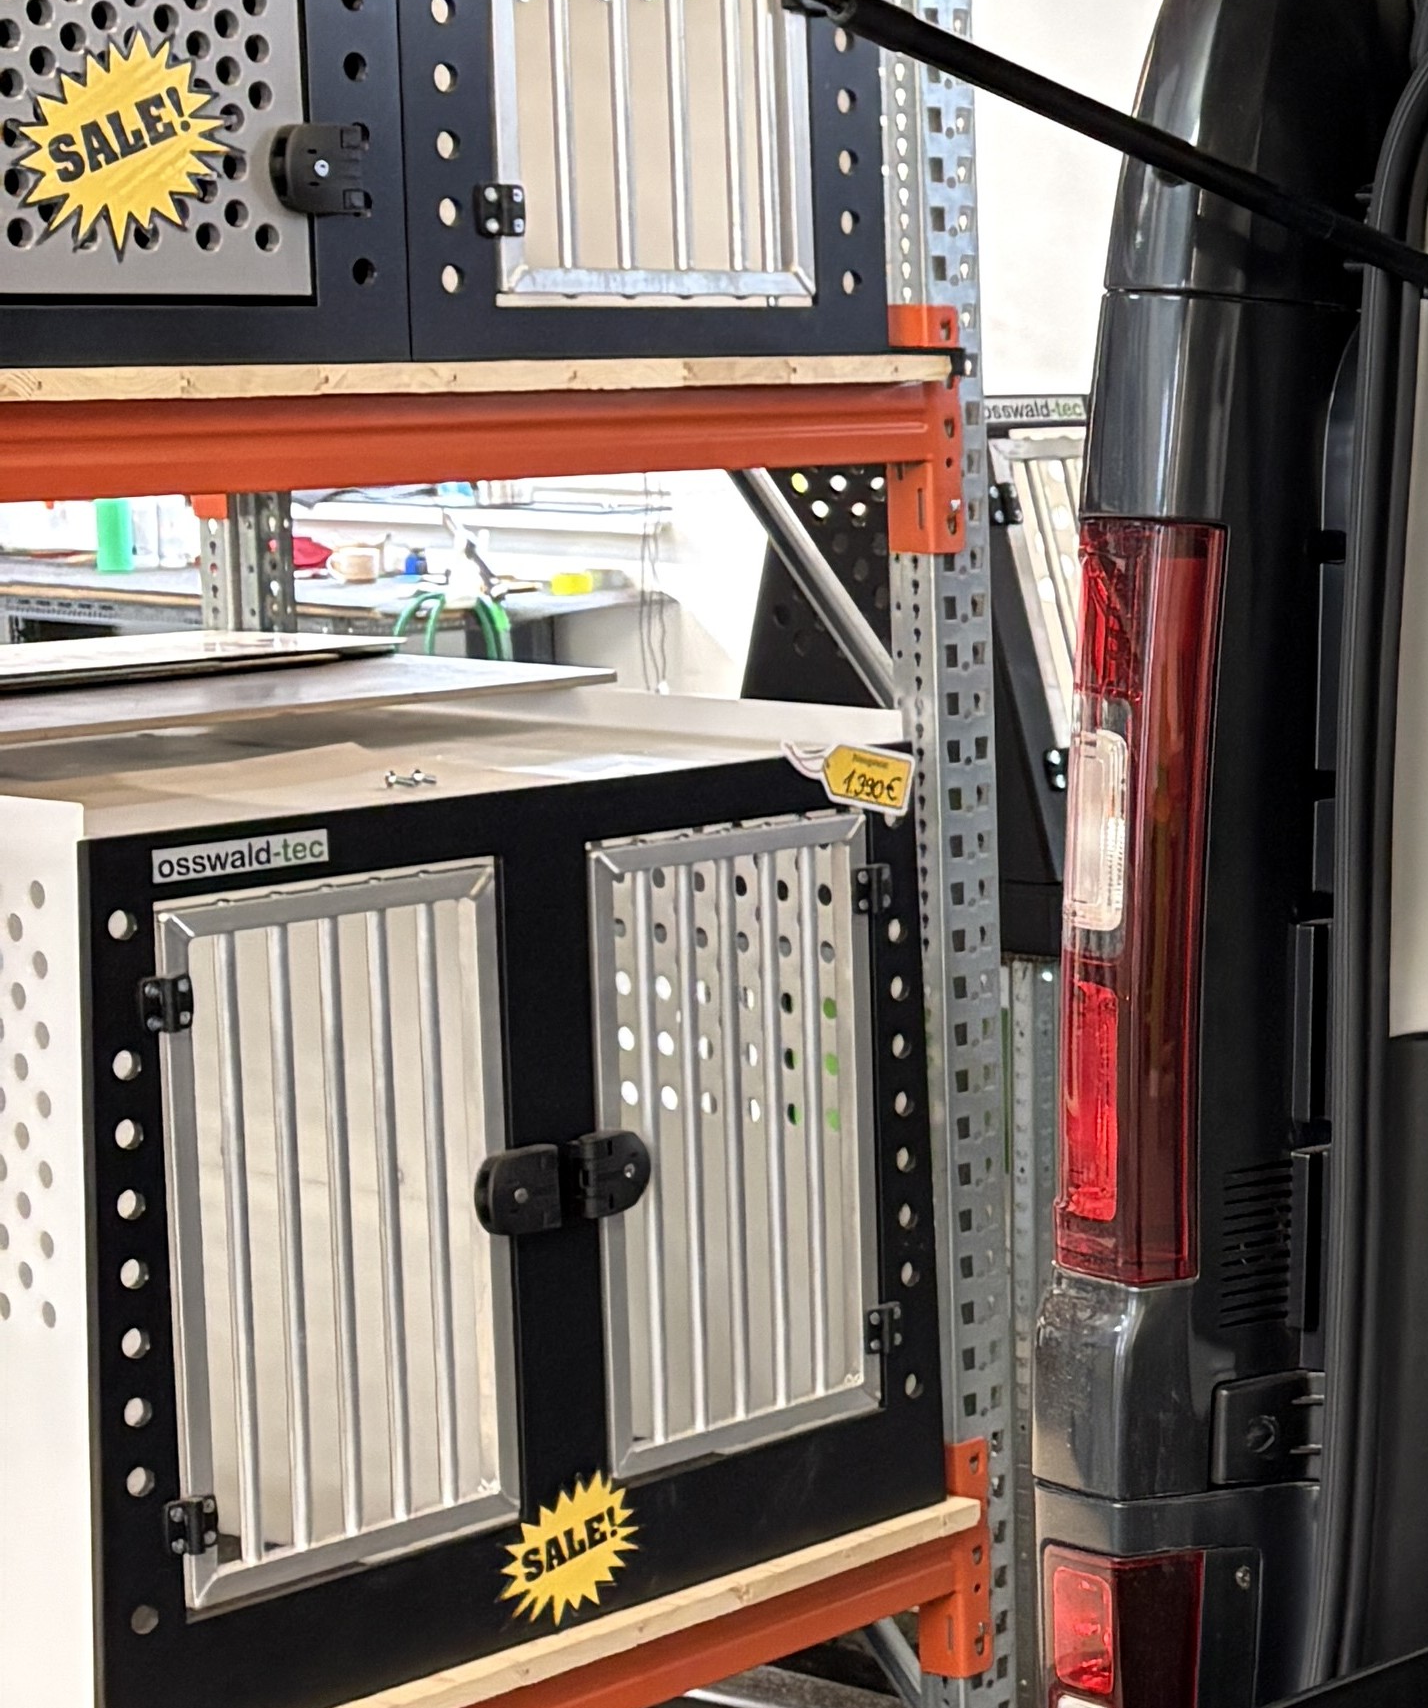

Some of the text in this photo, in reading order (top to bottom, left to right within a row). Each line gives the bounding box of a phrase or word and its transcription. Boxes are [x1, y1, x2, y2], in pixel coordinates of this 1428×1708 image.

[48, 86, 191, 183] SALE!
[157, 838, 324, 879] osswald-tec
[521, 1505, 618, 1583] SALE!
